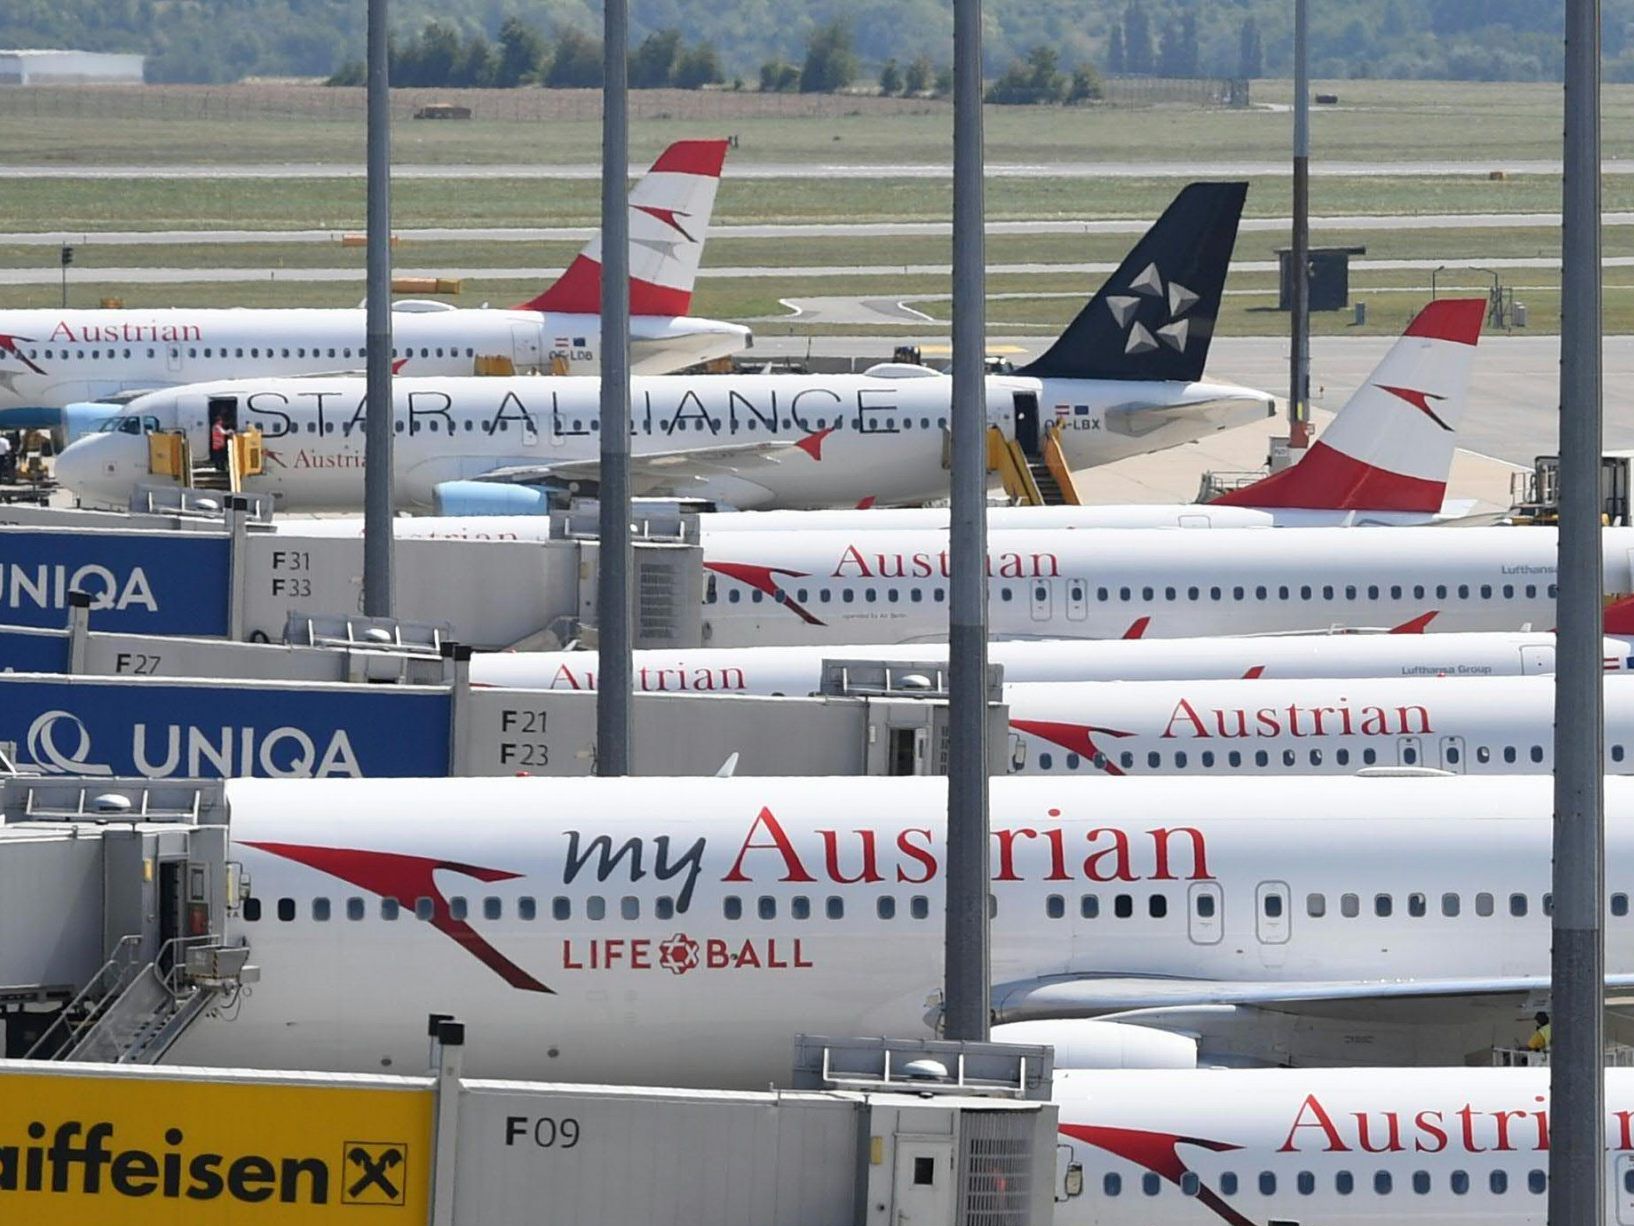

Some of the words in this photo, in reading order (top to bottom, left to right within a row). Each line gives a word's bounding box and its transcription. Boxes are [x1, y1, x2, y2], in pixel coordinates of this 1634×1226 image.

[50, 320, 203, 342] Austrian
[489, 388, 900, 436] ALIANCE
[0, 563, 158, 611] NIQA
[1402, 665, 1455, 675] Lufthansa
[1457, 664, 1492, 676] Group
[1159, 696, 1436, 738] Austrian
[133, 723, 363, 778] UNIQA
[562, 830, 707, 914] my
[720, 806, 1217, 884] Ausrian
[563, 939, 651, 969] LIFE
[706, 938, 813, 969] BALL
